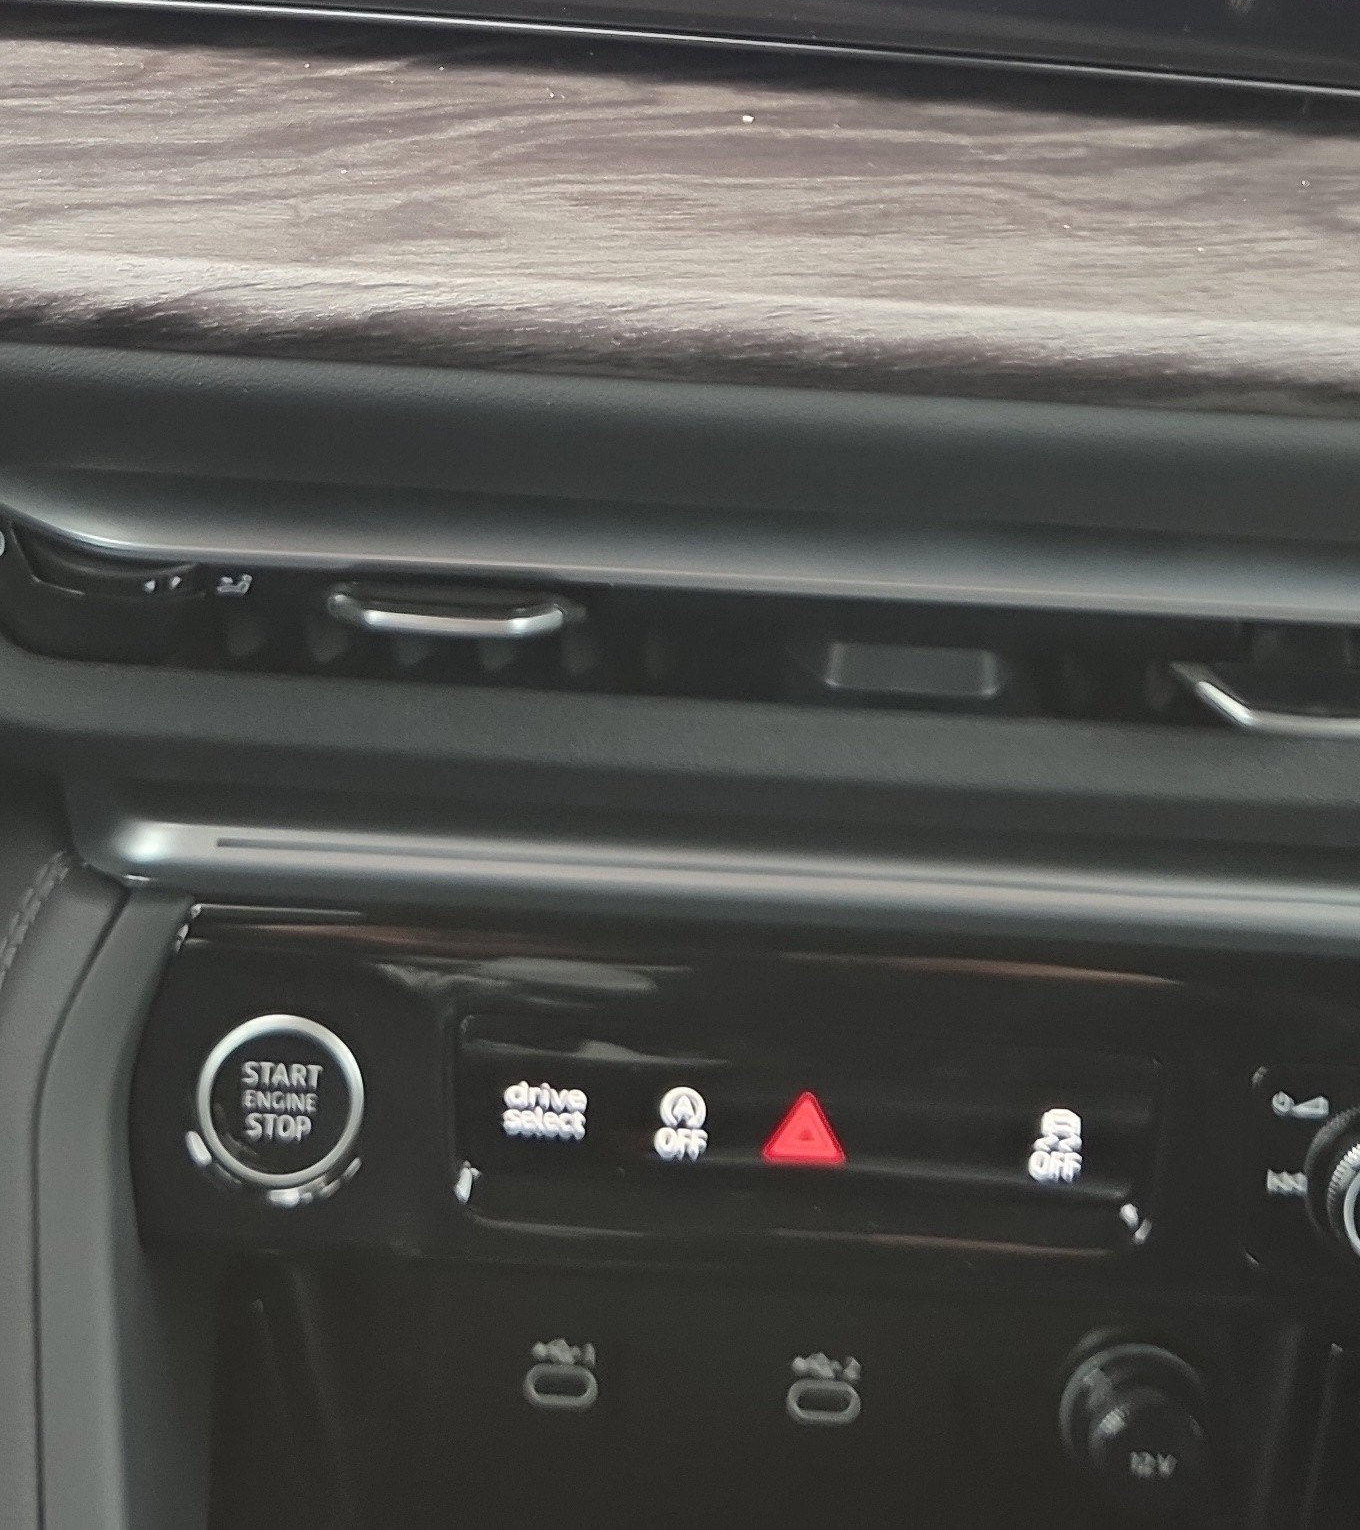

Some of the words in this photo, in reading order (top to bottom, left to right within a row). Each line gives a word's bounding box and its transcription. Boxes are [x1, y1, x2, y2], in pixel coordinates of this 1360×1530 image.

[240, 1060, 324, 1089] START
[242, 1089, 319, 1115] ENGINE
[502, 1080, 589, 1112] drive
[244, 1113, 313, 1143] STOP
[502, 1107, 587, 1141] select
[653, 1127, 709, 1161] OFF
[1028, 1151, 1084, 1183] OFF
